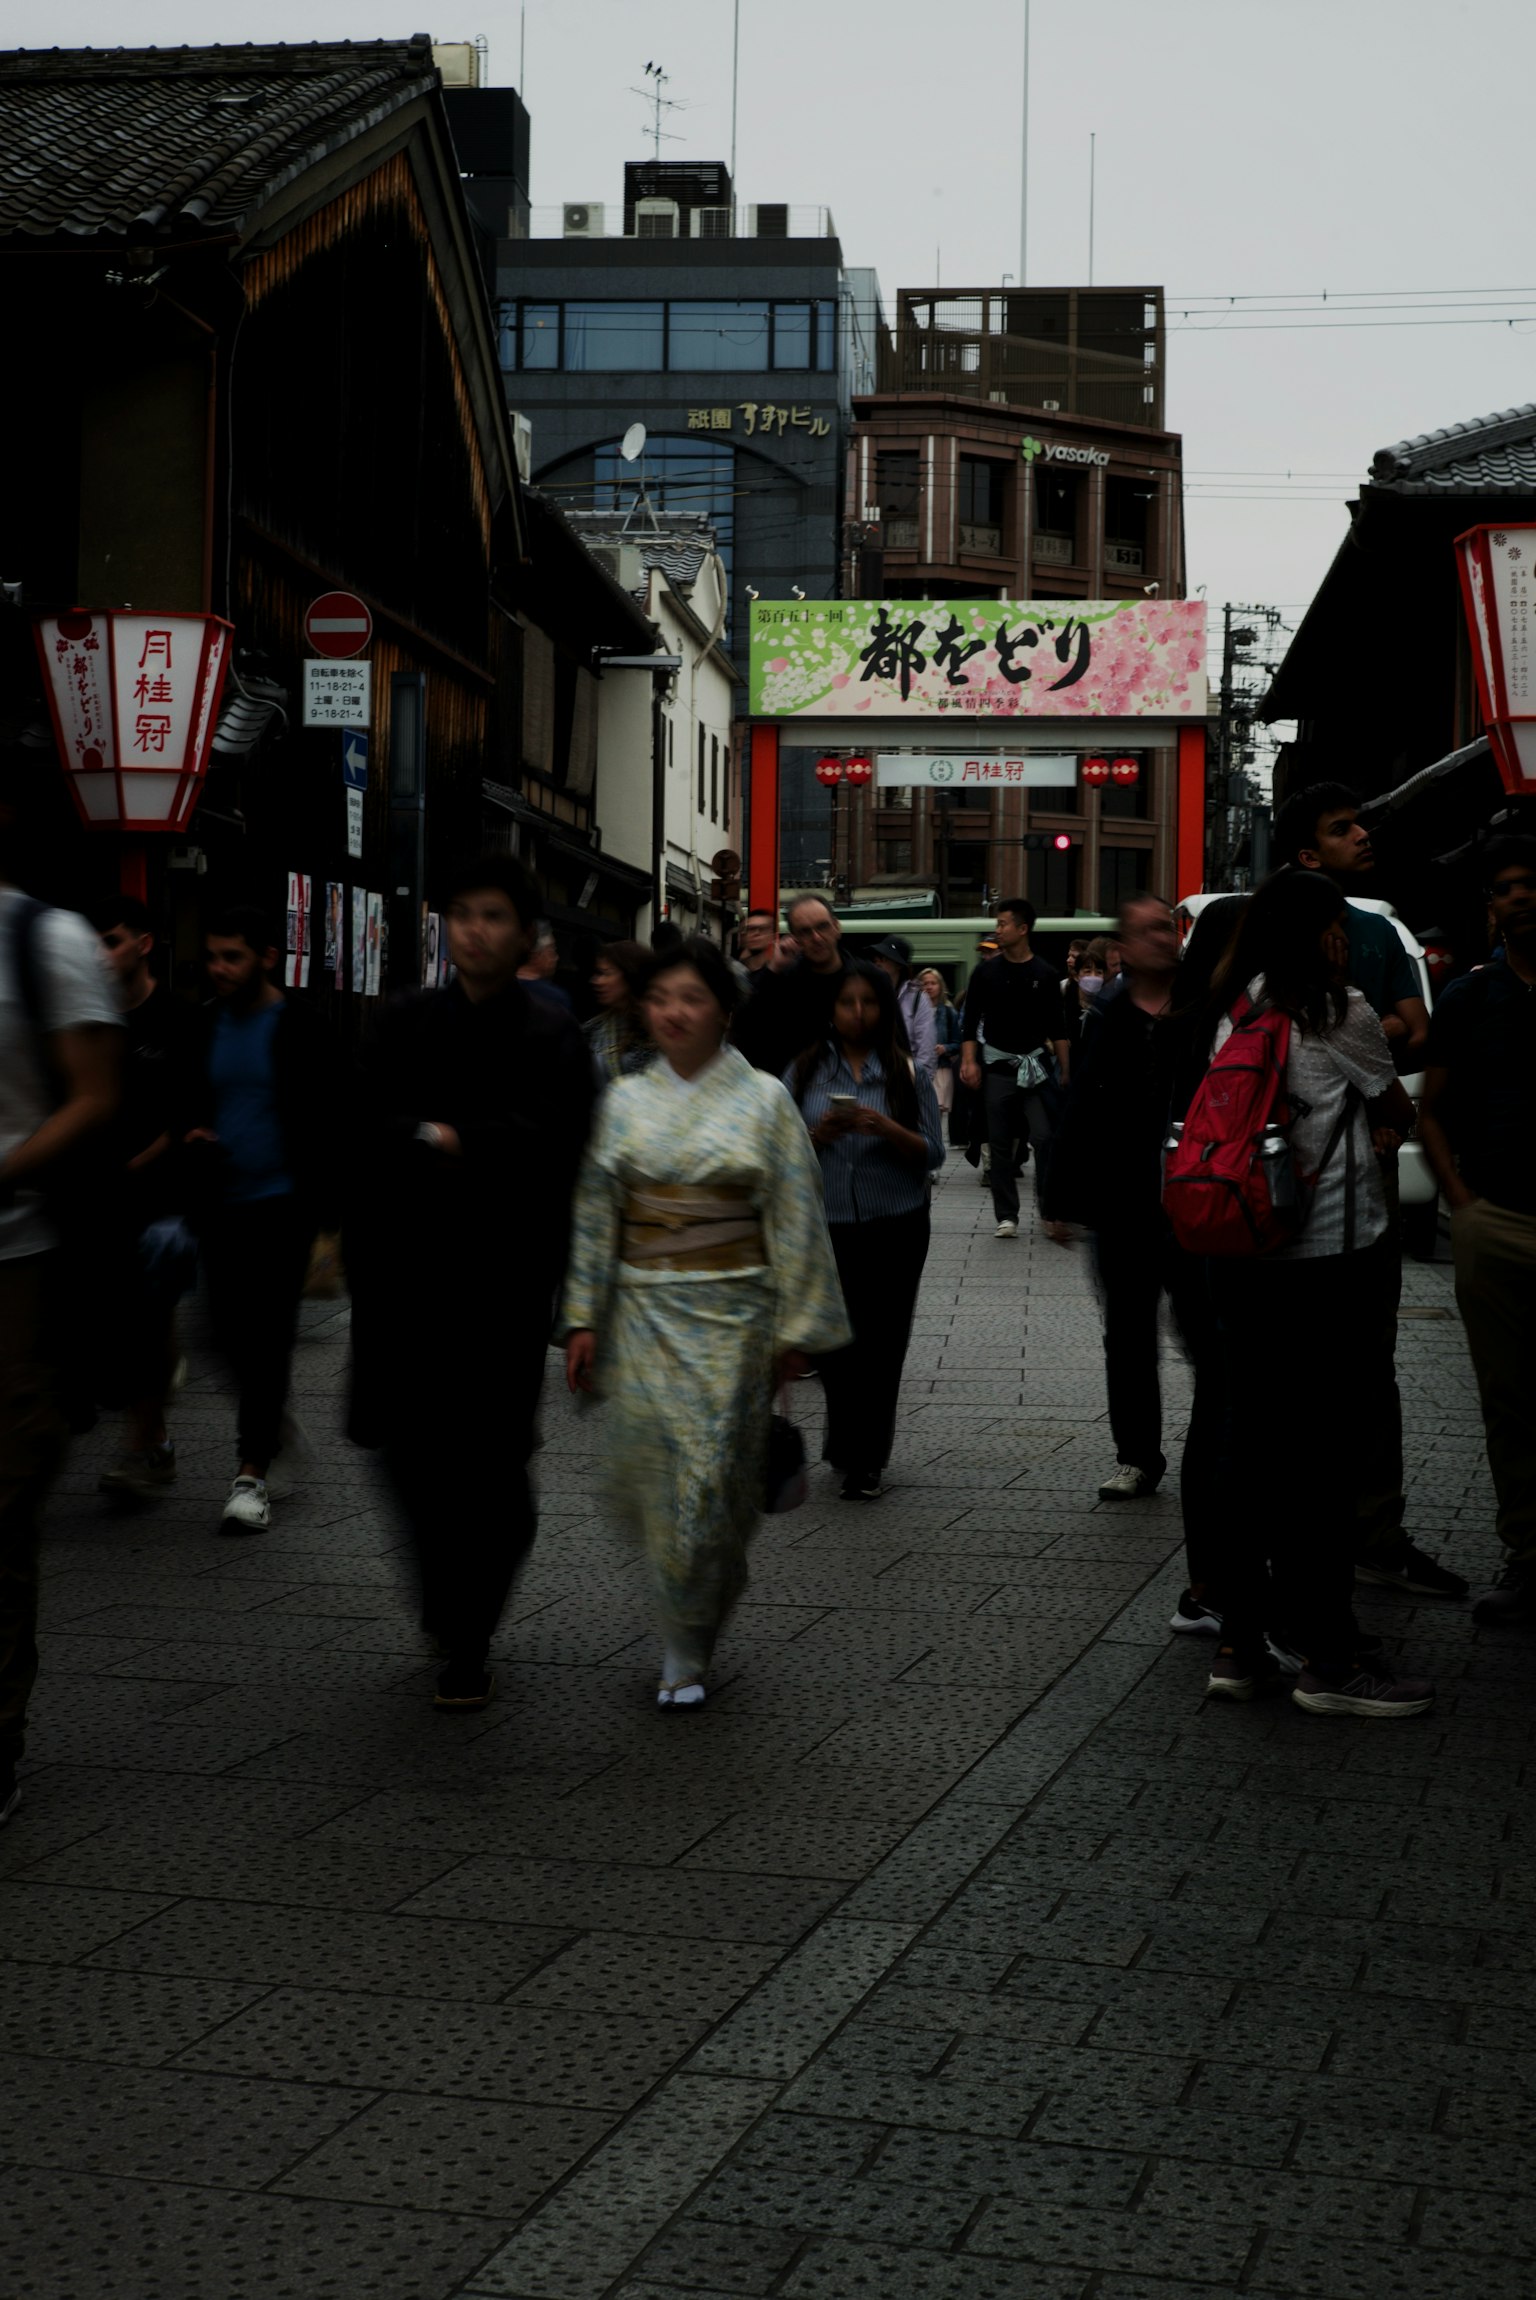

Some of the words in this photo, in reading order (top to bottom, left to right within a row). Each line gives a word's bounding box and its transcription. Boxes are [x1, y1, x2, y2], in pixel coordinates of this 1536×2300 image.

[1044, 443, 1111, 467] yasaka
[757, 608, 843, 624] 第百五十一回
[859, 608, 1091, 702] 都をどり
[311, 667, 364, 678] 自転車を除く
[72, 652, 93, 738] 都をどり
[133, 629, 174, 753] 月桂冠
[962, 761, 1024, 782] 月桂冠
